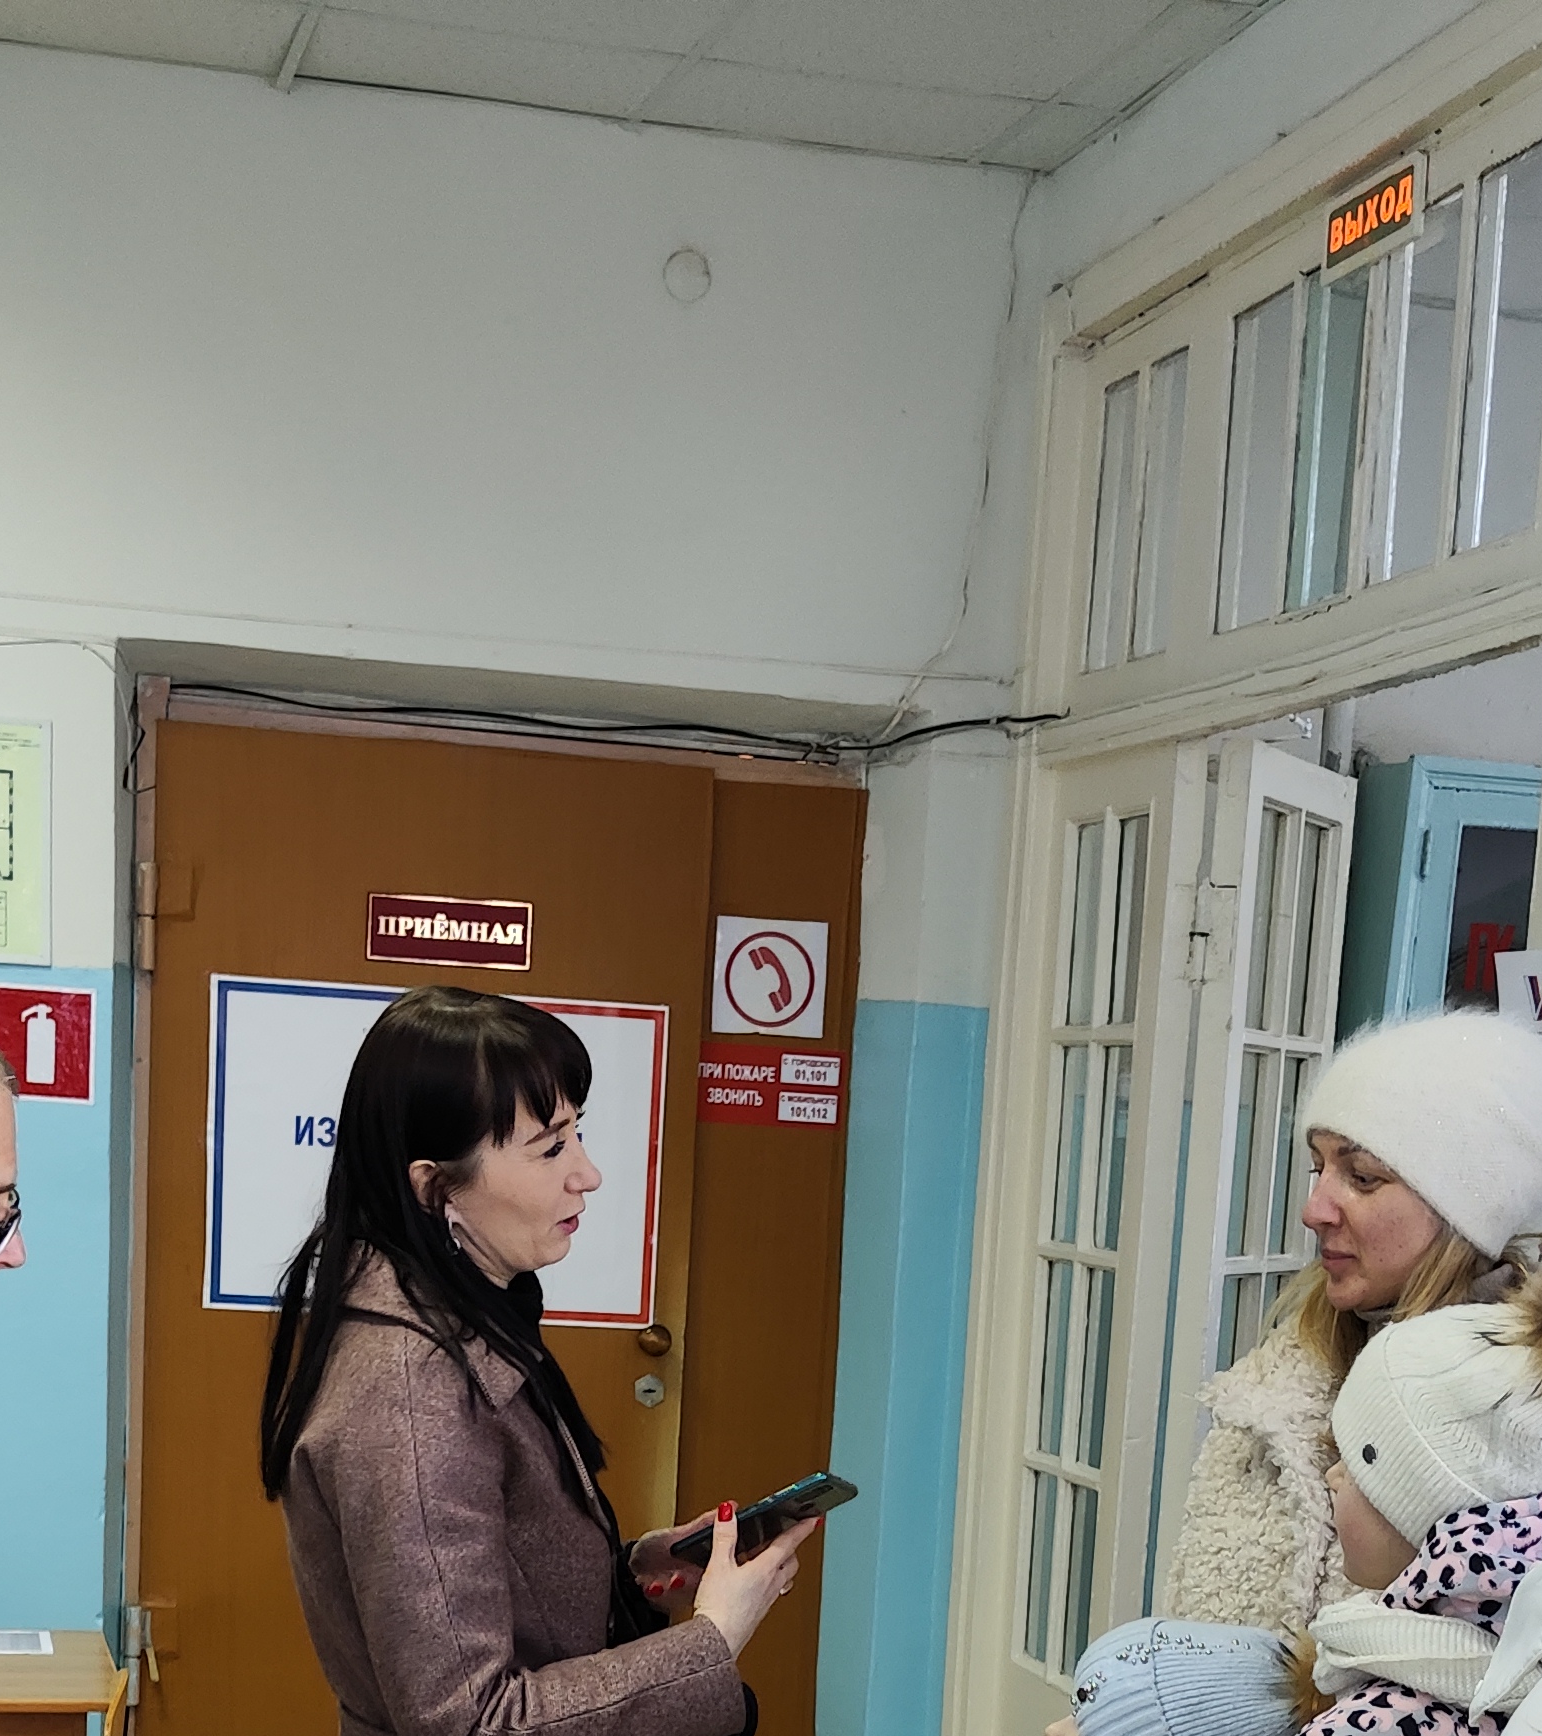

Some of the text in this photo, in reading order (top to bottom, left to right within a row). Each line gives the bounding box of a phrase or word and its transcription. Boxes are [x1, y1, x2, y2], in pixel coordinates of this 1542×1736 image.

[1330, 174, 1412, 254] ВЫХОД
[377, 911, 524, 947] ПРИЁМНАЯ
[698, 1062, 776, 1083] ПРИ ПОЖАРЕ
[707, 1088, 763, 1107] ЗВОНИТЬ
[791, 1107, 828, 1119] 101,112
